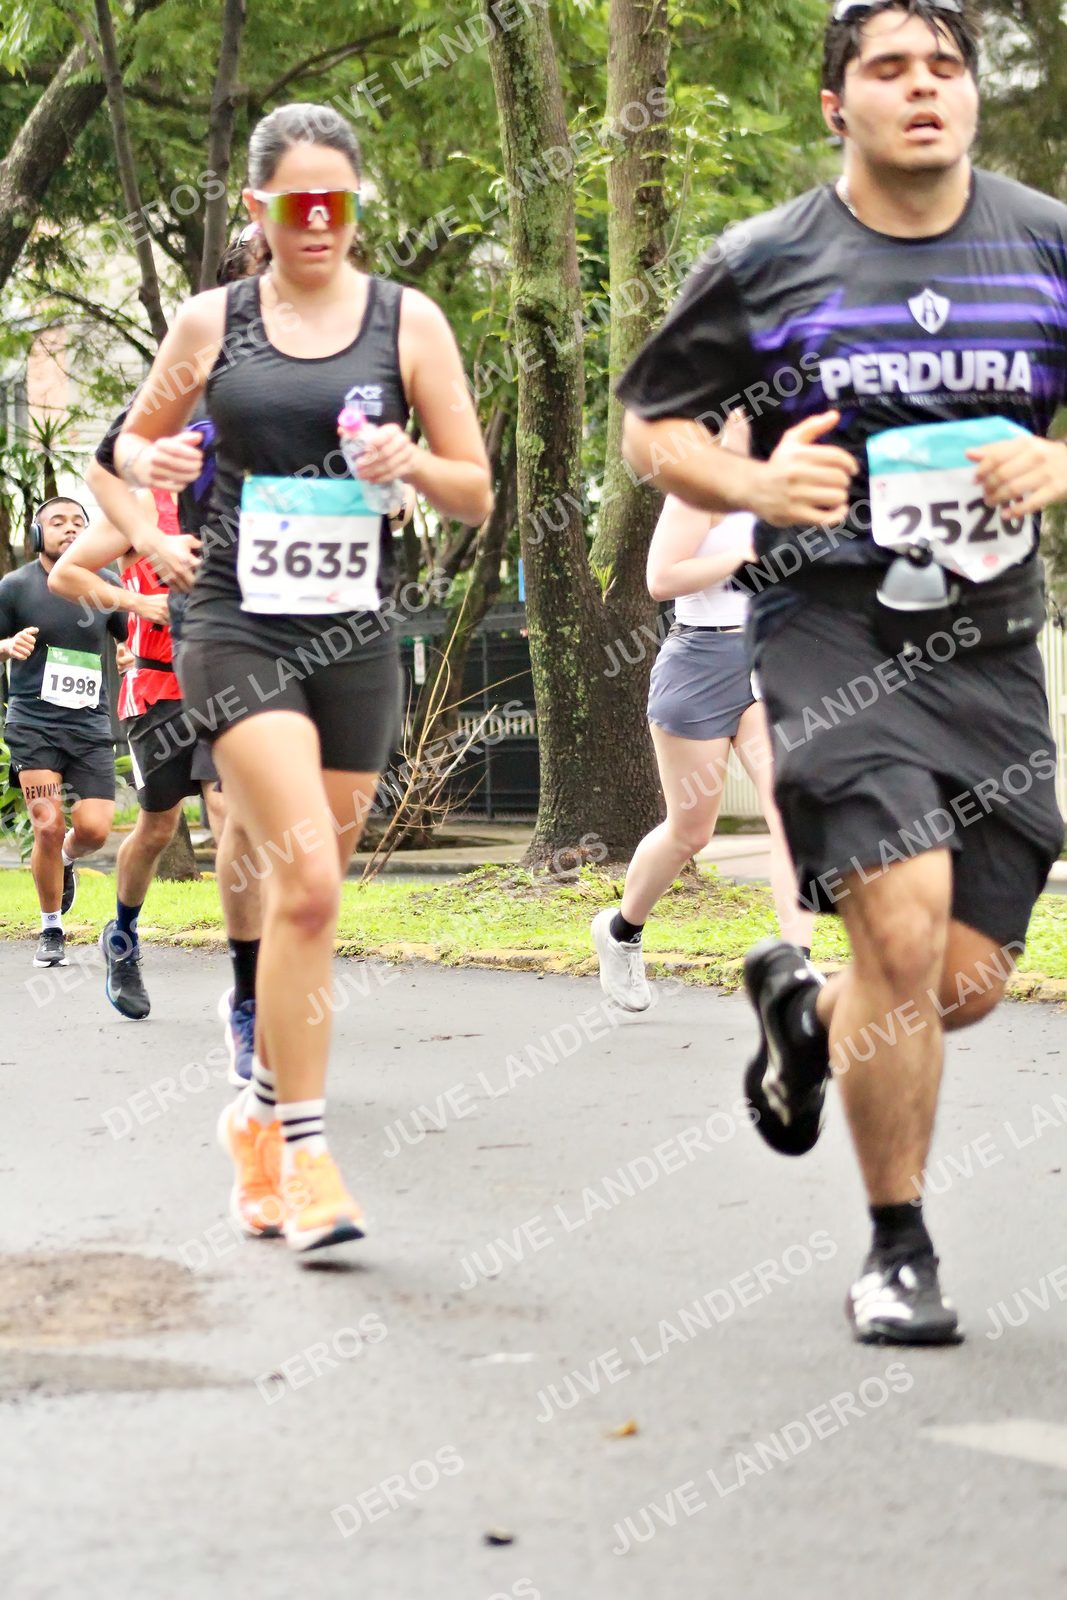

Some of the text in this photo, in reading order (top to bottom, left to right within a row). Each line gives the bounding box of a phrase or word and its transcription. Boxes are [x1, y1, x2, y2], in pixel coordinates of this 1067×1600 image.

[818, 350, 1032, 400] PERDURA
[251, 540, 368, 580] 3635
[50, 674, 97, 697] 1998
